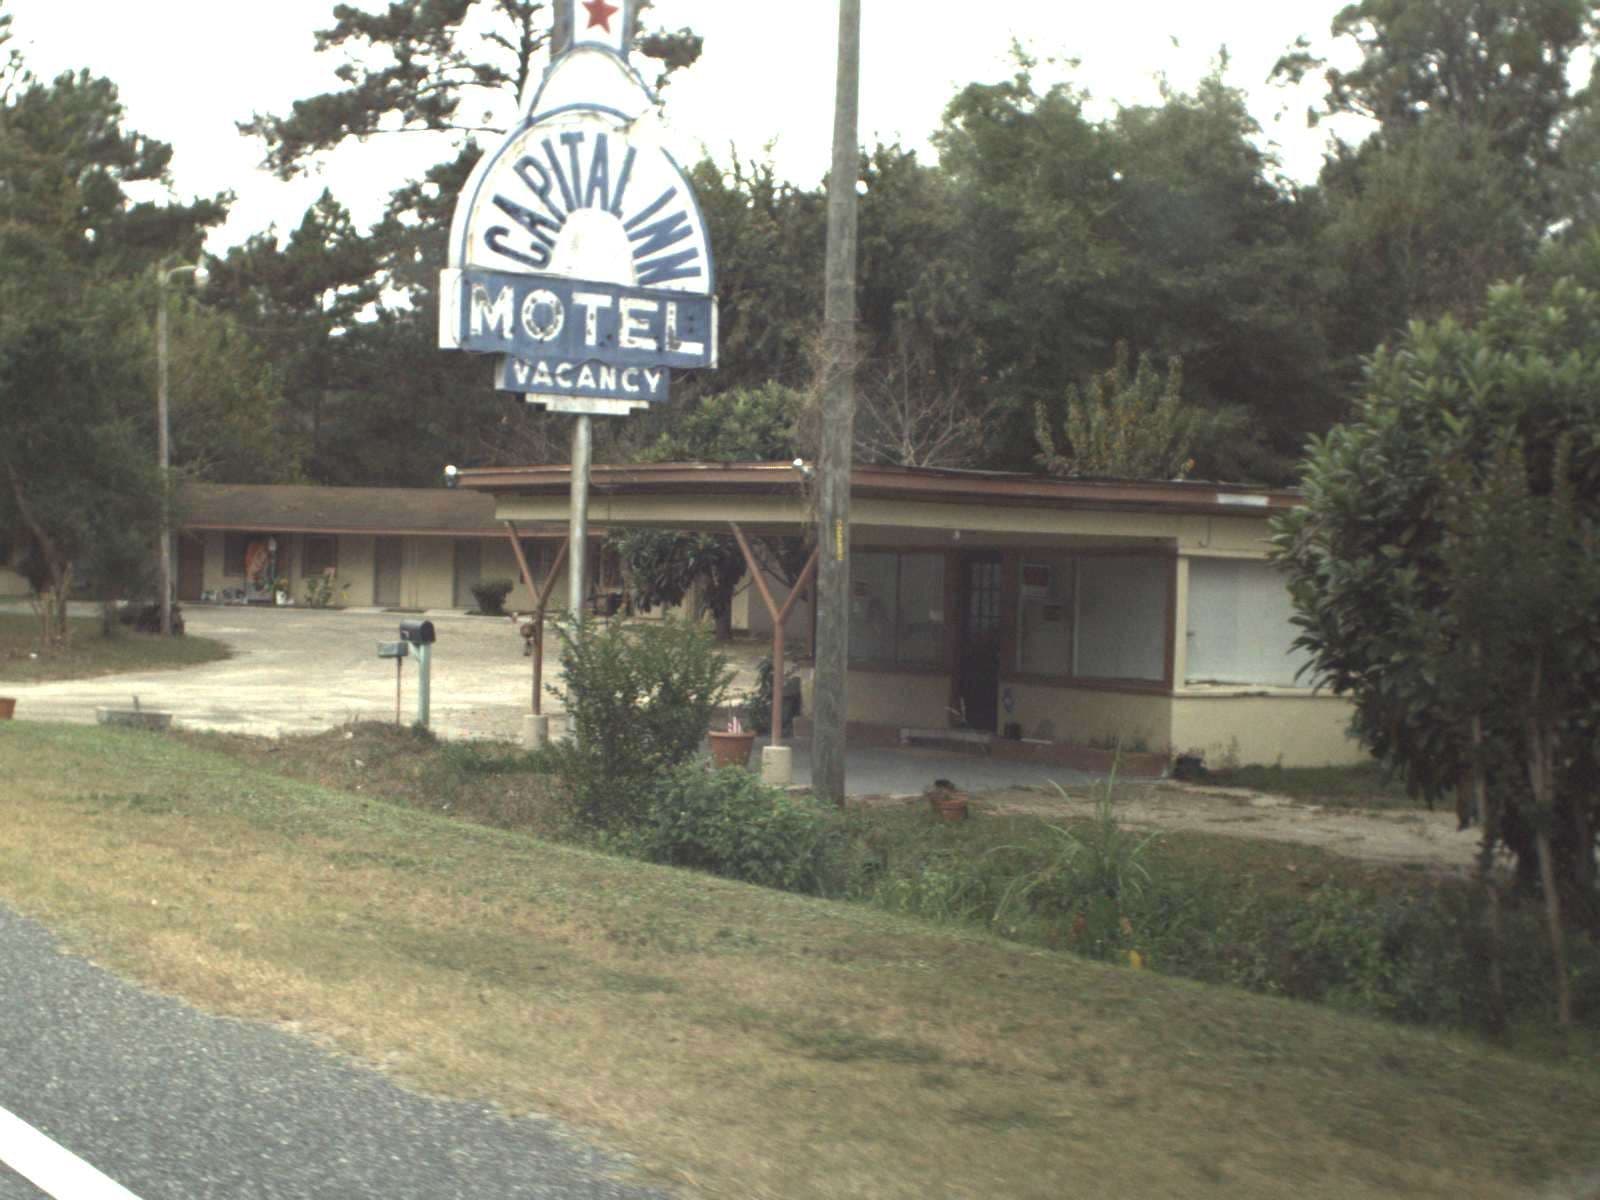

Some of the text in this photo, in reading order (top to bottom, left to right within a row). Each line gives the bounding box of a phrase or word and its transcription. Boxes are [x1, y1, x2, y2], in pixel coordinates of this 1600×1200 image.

[485, 132, 702, 286] CAPITAL INN
[471, 286, 704, 355] MOTEL
[514, 361, 662, 393] VACANCY
